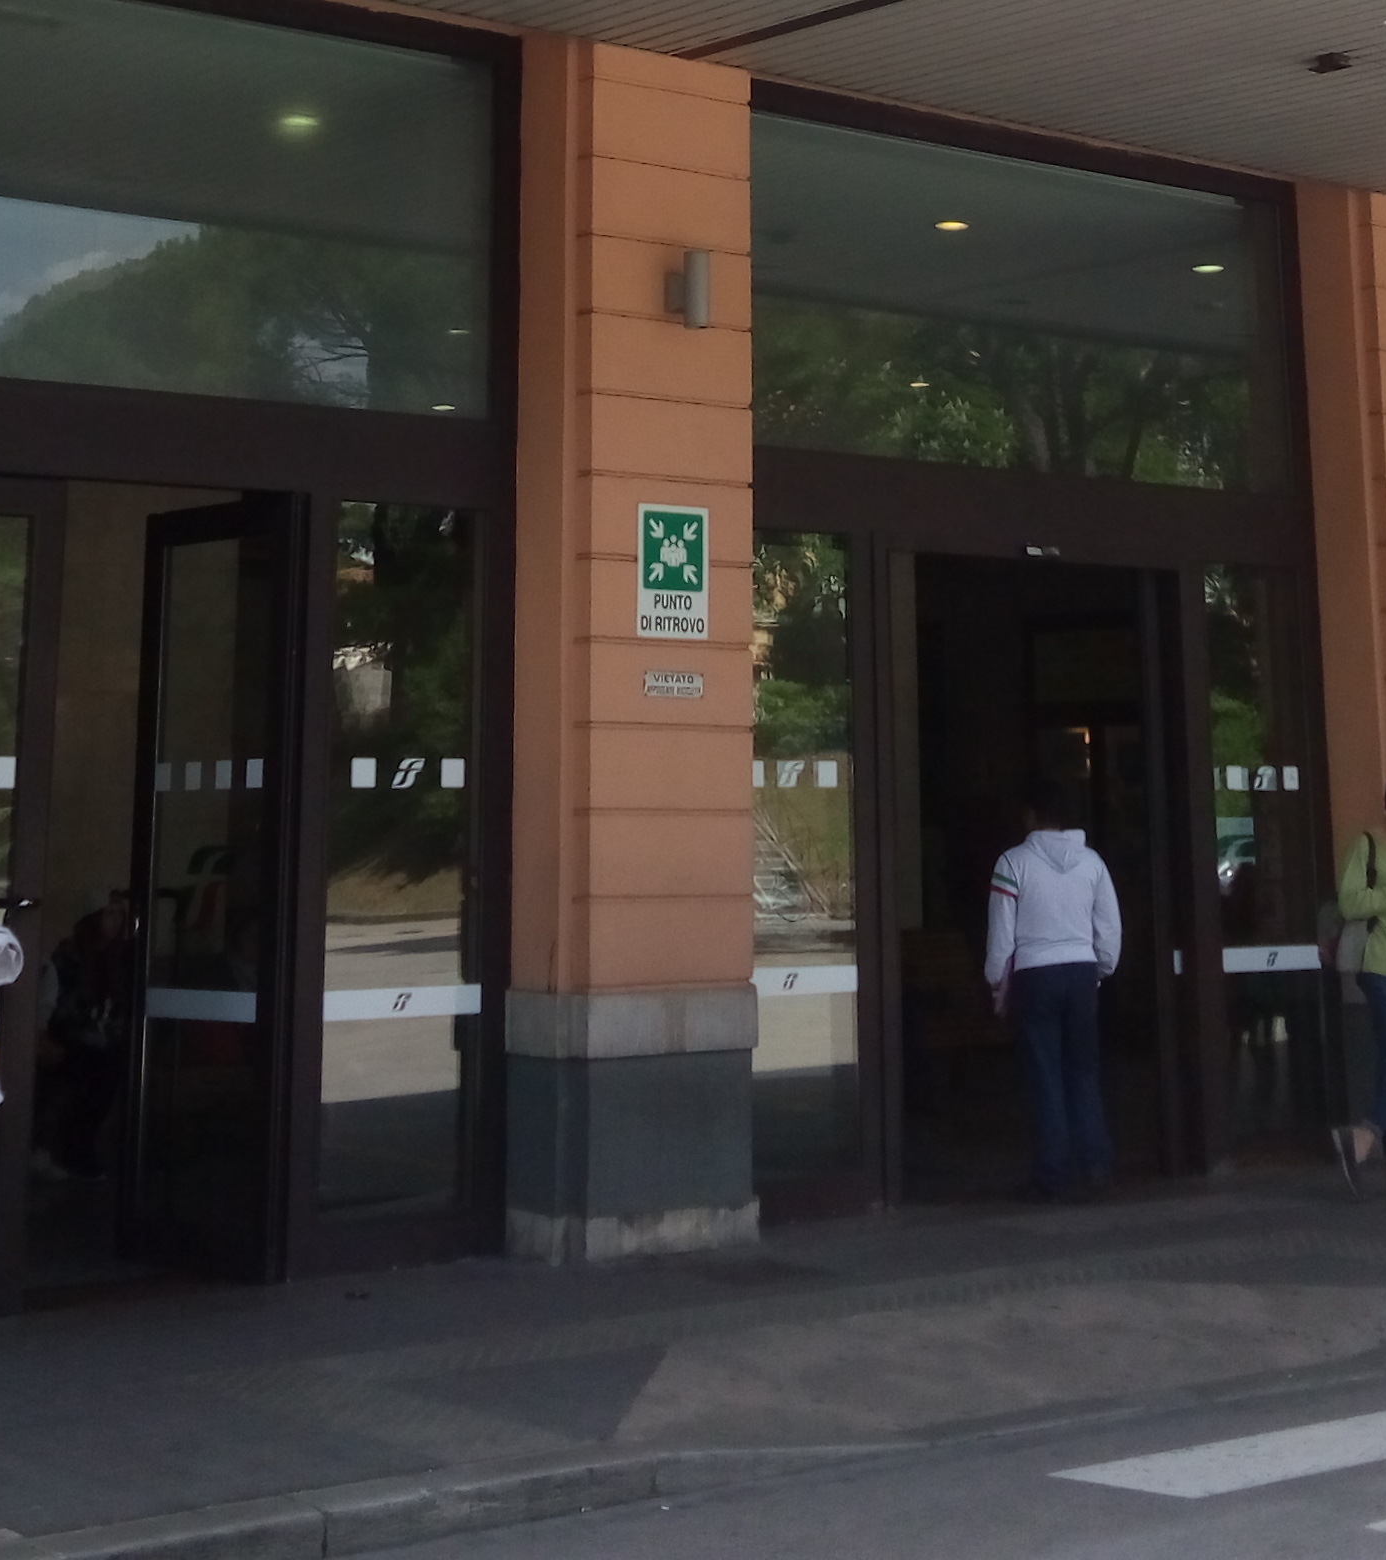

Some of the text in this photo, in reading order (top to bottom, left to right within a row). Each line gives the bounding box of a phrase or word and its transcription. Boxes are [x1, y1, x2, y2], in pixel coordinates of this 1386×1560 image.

[654, 593, 692, 611] PUNTO
[641, 614, 705, 634] DI RITROVO
[653, 673, 694, 684] VIETATO
